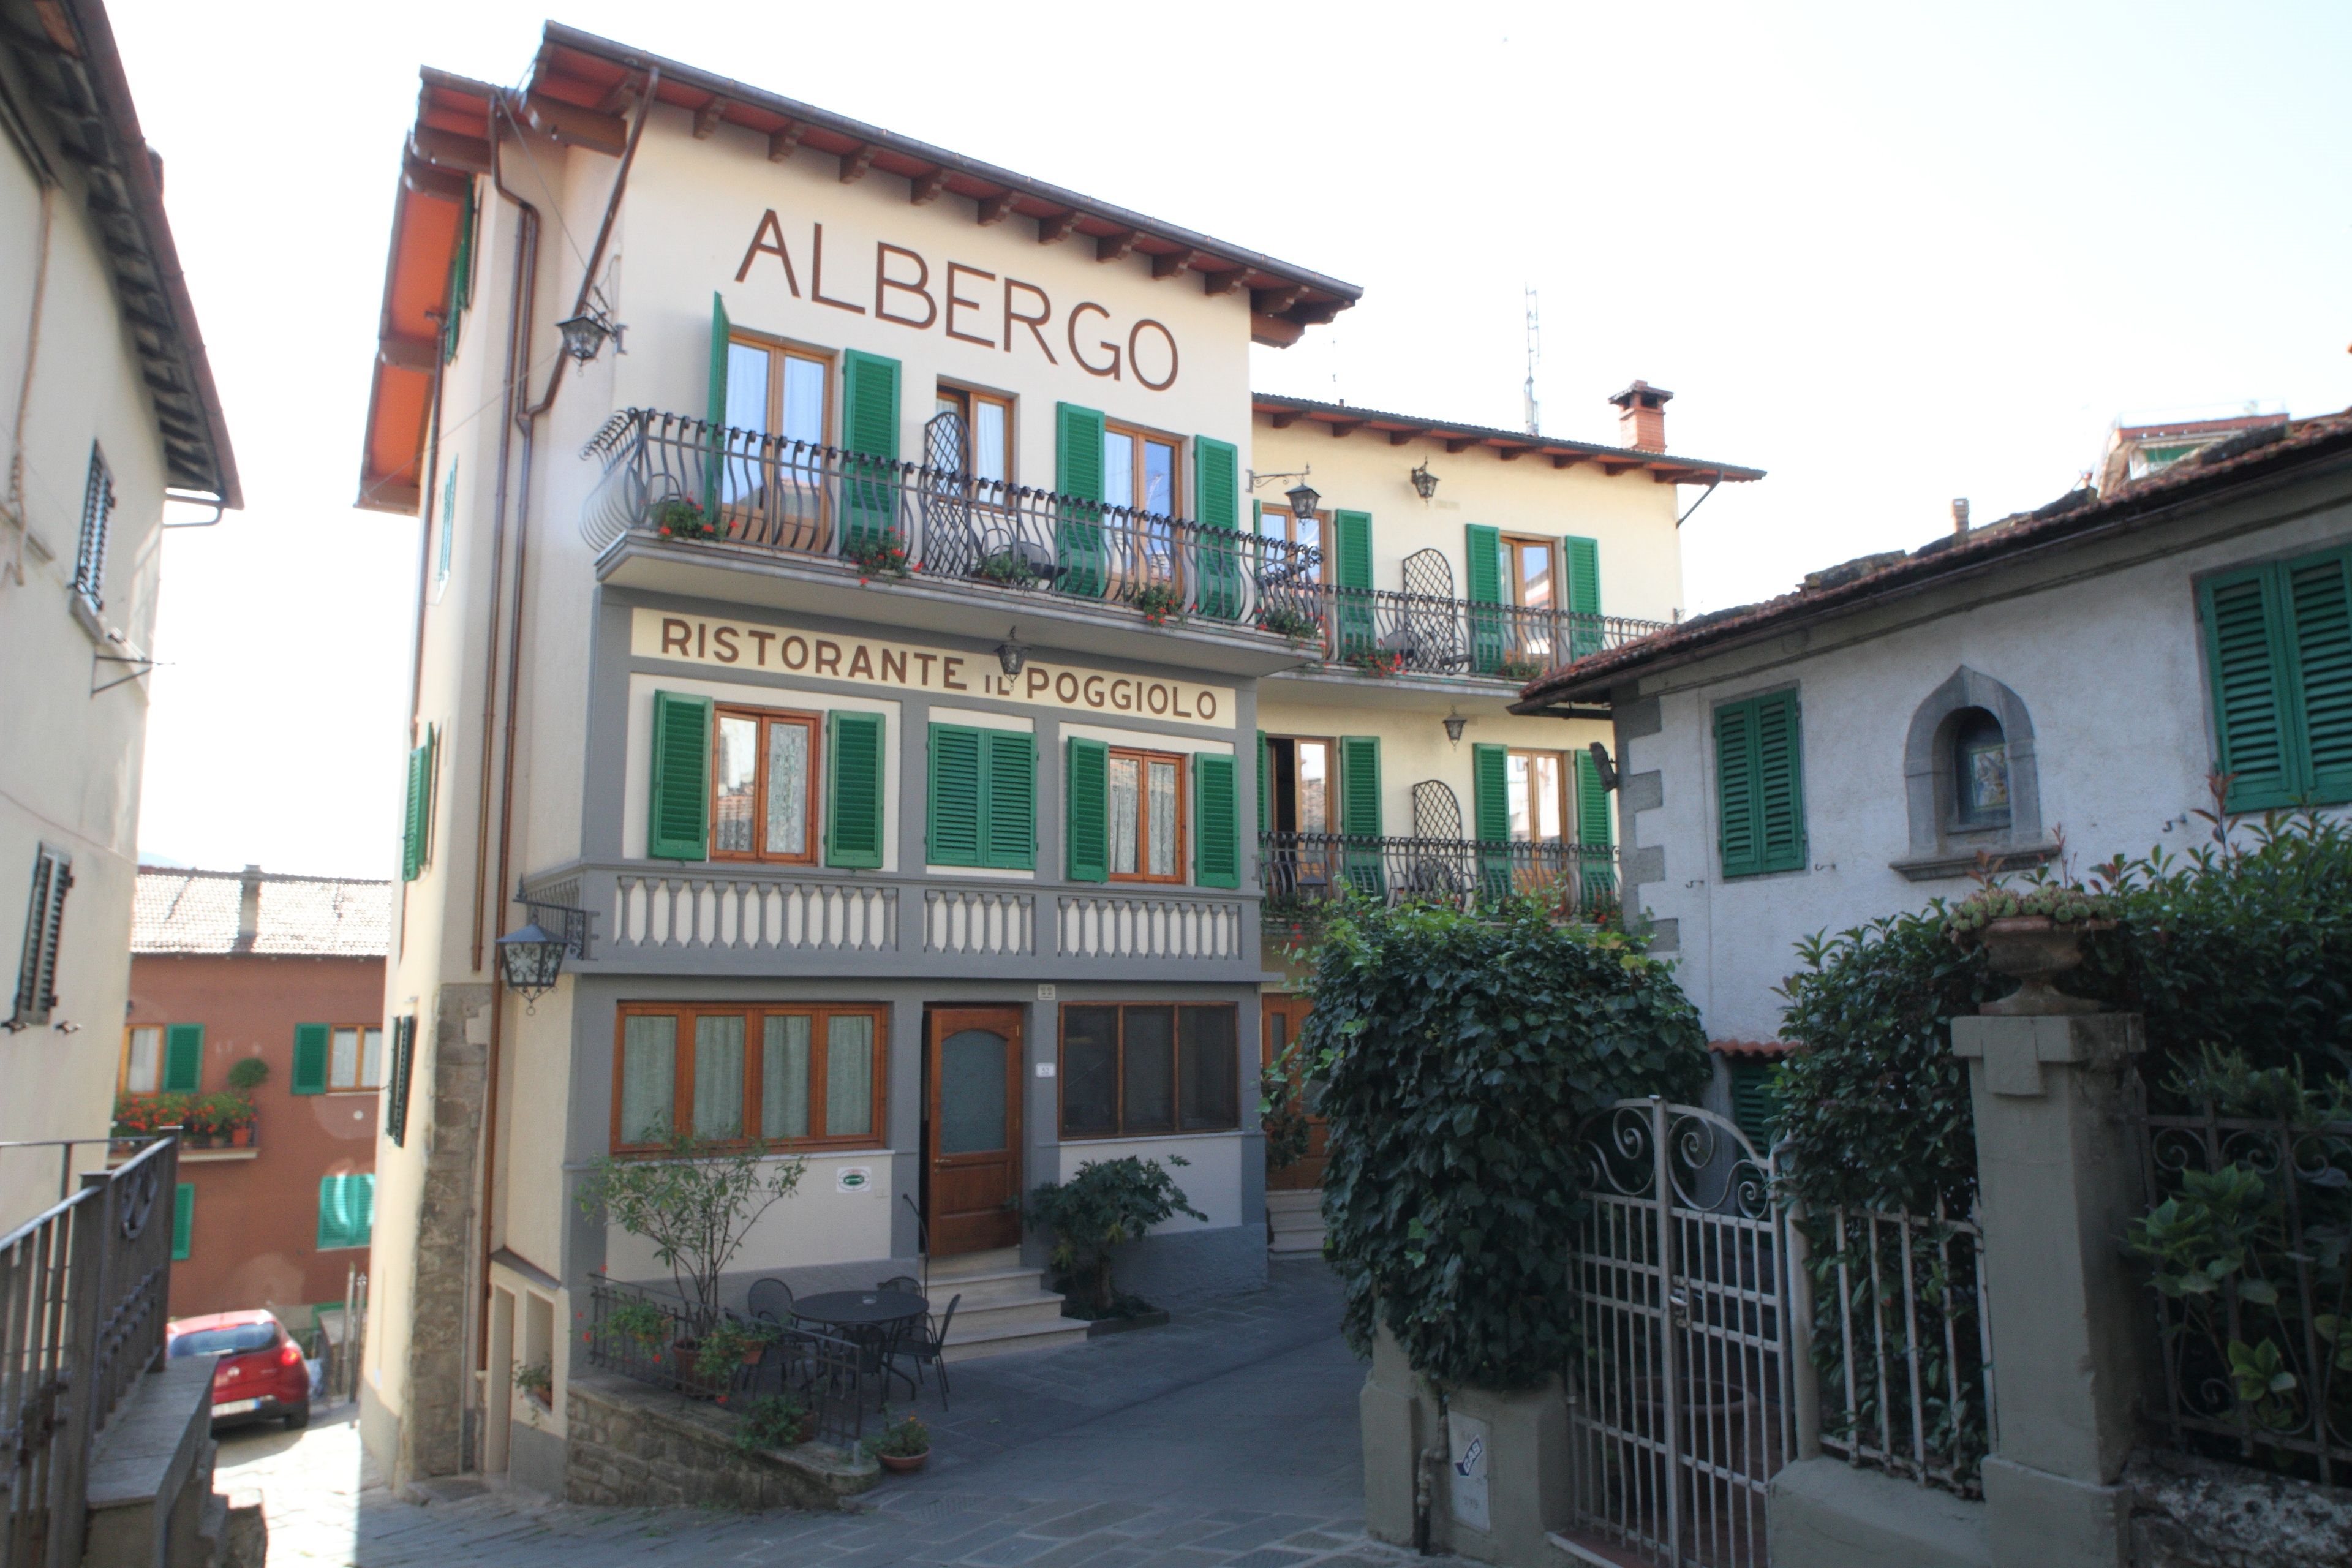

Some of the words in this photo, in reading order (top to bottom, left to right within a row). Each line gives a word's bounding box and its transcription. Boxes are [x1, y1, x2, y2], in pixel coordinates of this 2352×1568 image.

[734, 208, 1179, 392] ALBERGO
[661, 617, 967, 691] RISTORANTE
[985, 674, 1010, 696] IL
[1027, 666, 1217, 720] POGGIOLO
[1463, 1441, 1481, 1474] GAS
